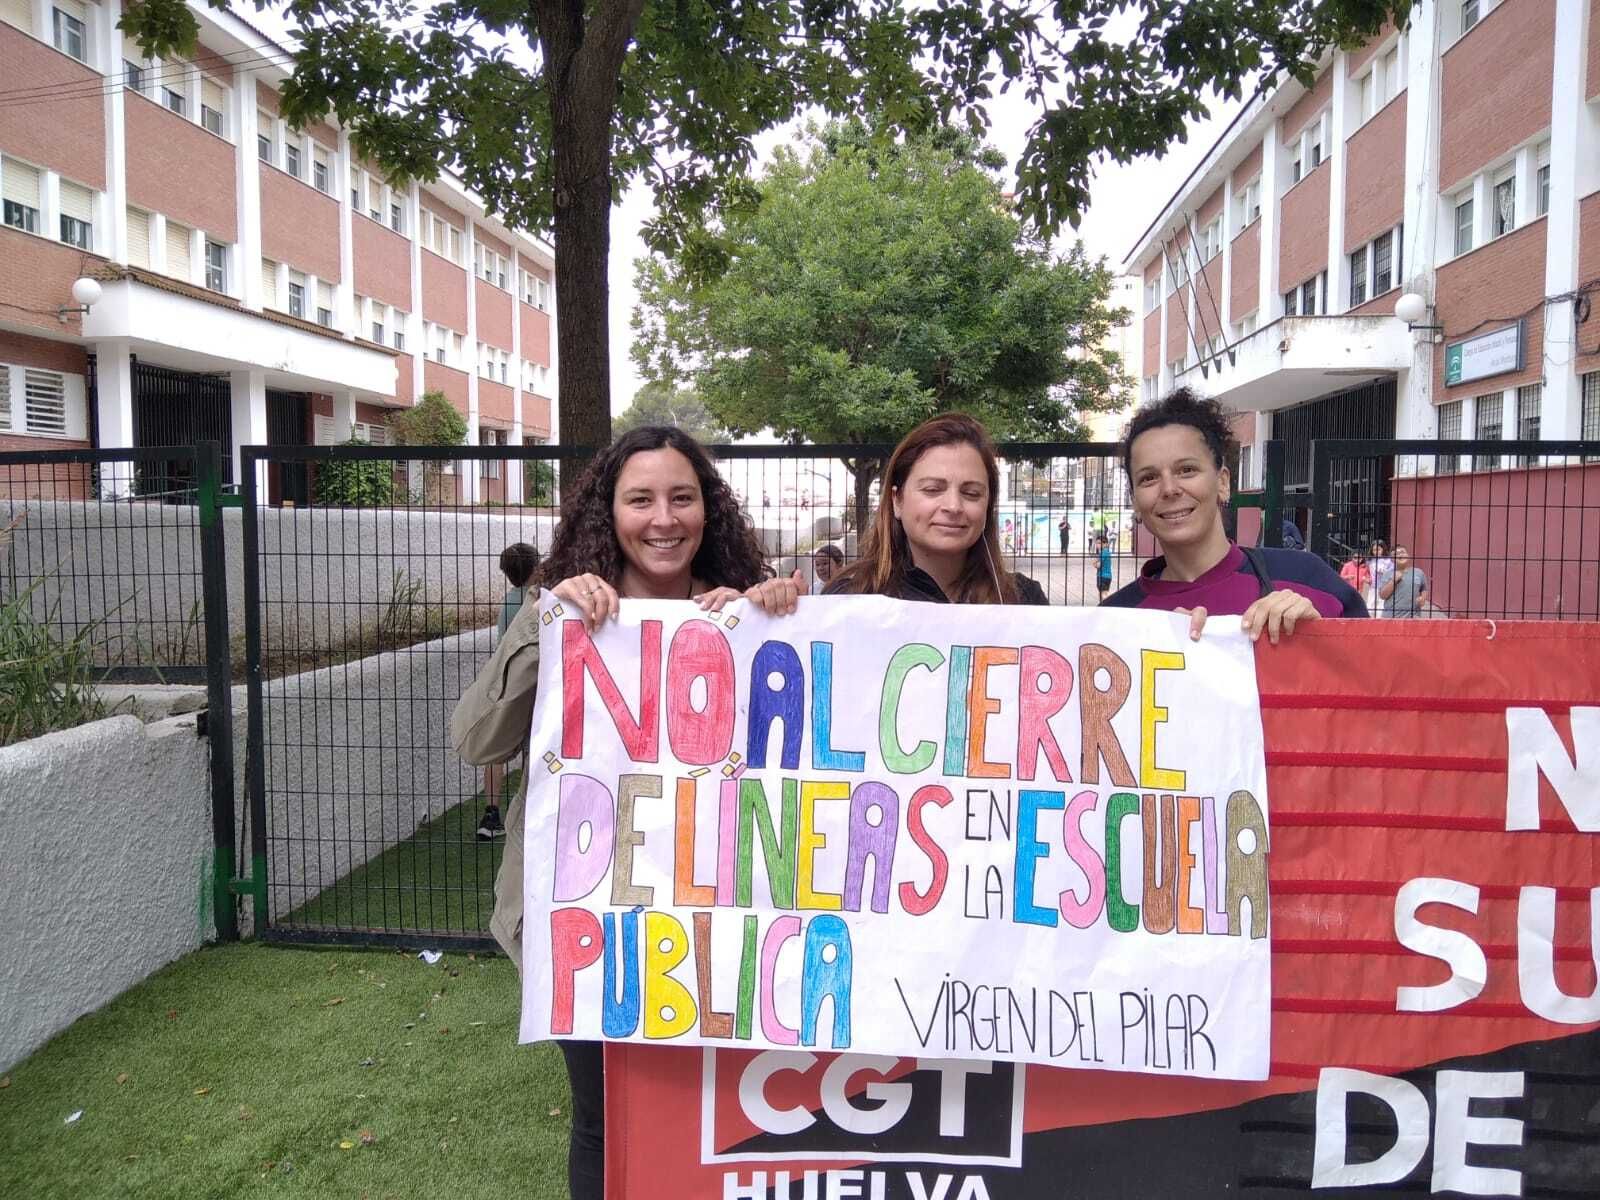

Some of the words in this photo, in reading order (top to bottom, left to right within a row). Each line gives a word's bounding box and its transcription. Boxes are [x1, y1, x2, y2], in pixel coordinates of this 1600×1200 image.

[561, 619, 736, 766] NO
[746, 640, 866, 772] AL
[878, 643, 1187, 791] CIERRE
[552, 773, 663, 907] DE
[673, 762, 954, 917] LÍNEAS
[965, 789, 1011, 841] EN
[1012, 790, 1270, 939] ESCUELA
[964, 864, 1003, 920] LA
[550, 905, 853, 1049] PÚBLICA
[1049, 990, 1104, 1063] DEL
[738, 1049, 993, 1138] CGT
[1311, 1067, 1525, 1197] DE
